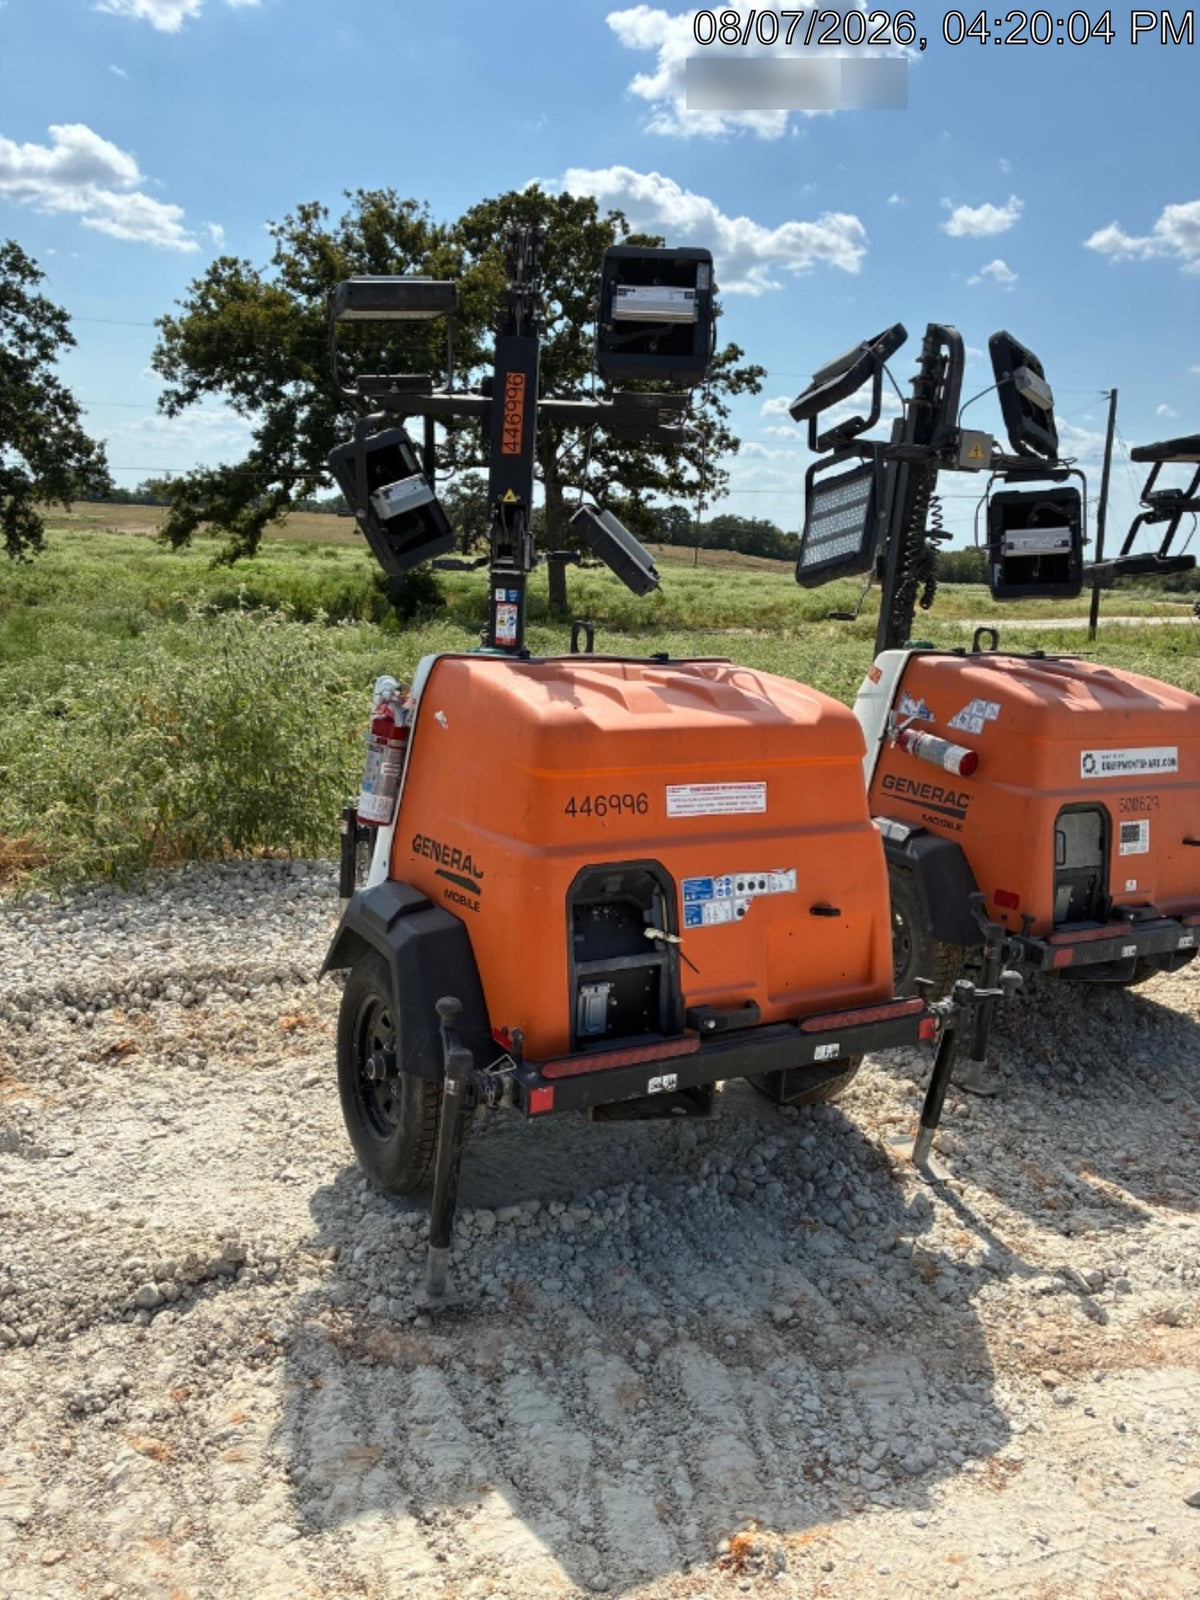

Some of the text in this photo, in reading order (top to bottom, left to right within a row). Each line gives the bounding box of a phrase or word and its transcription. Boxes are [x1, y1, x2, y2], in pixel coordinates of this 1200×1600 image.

[503, 374, 523, 453] 446996
[565, 792, 648, 818] 446996
[882, 774, 970, 808] GENERAC
[444, 888, 481, 913] MOBILE
